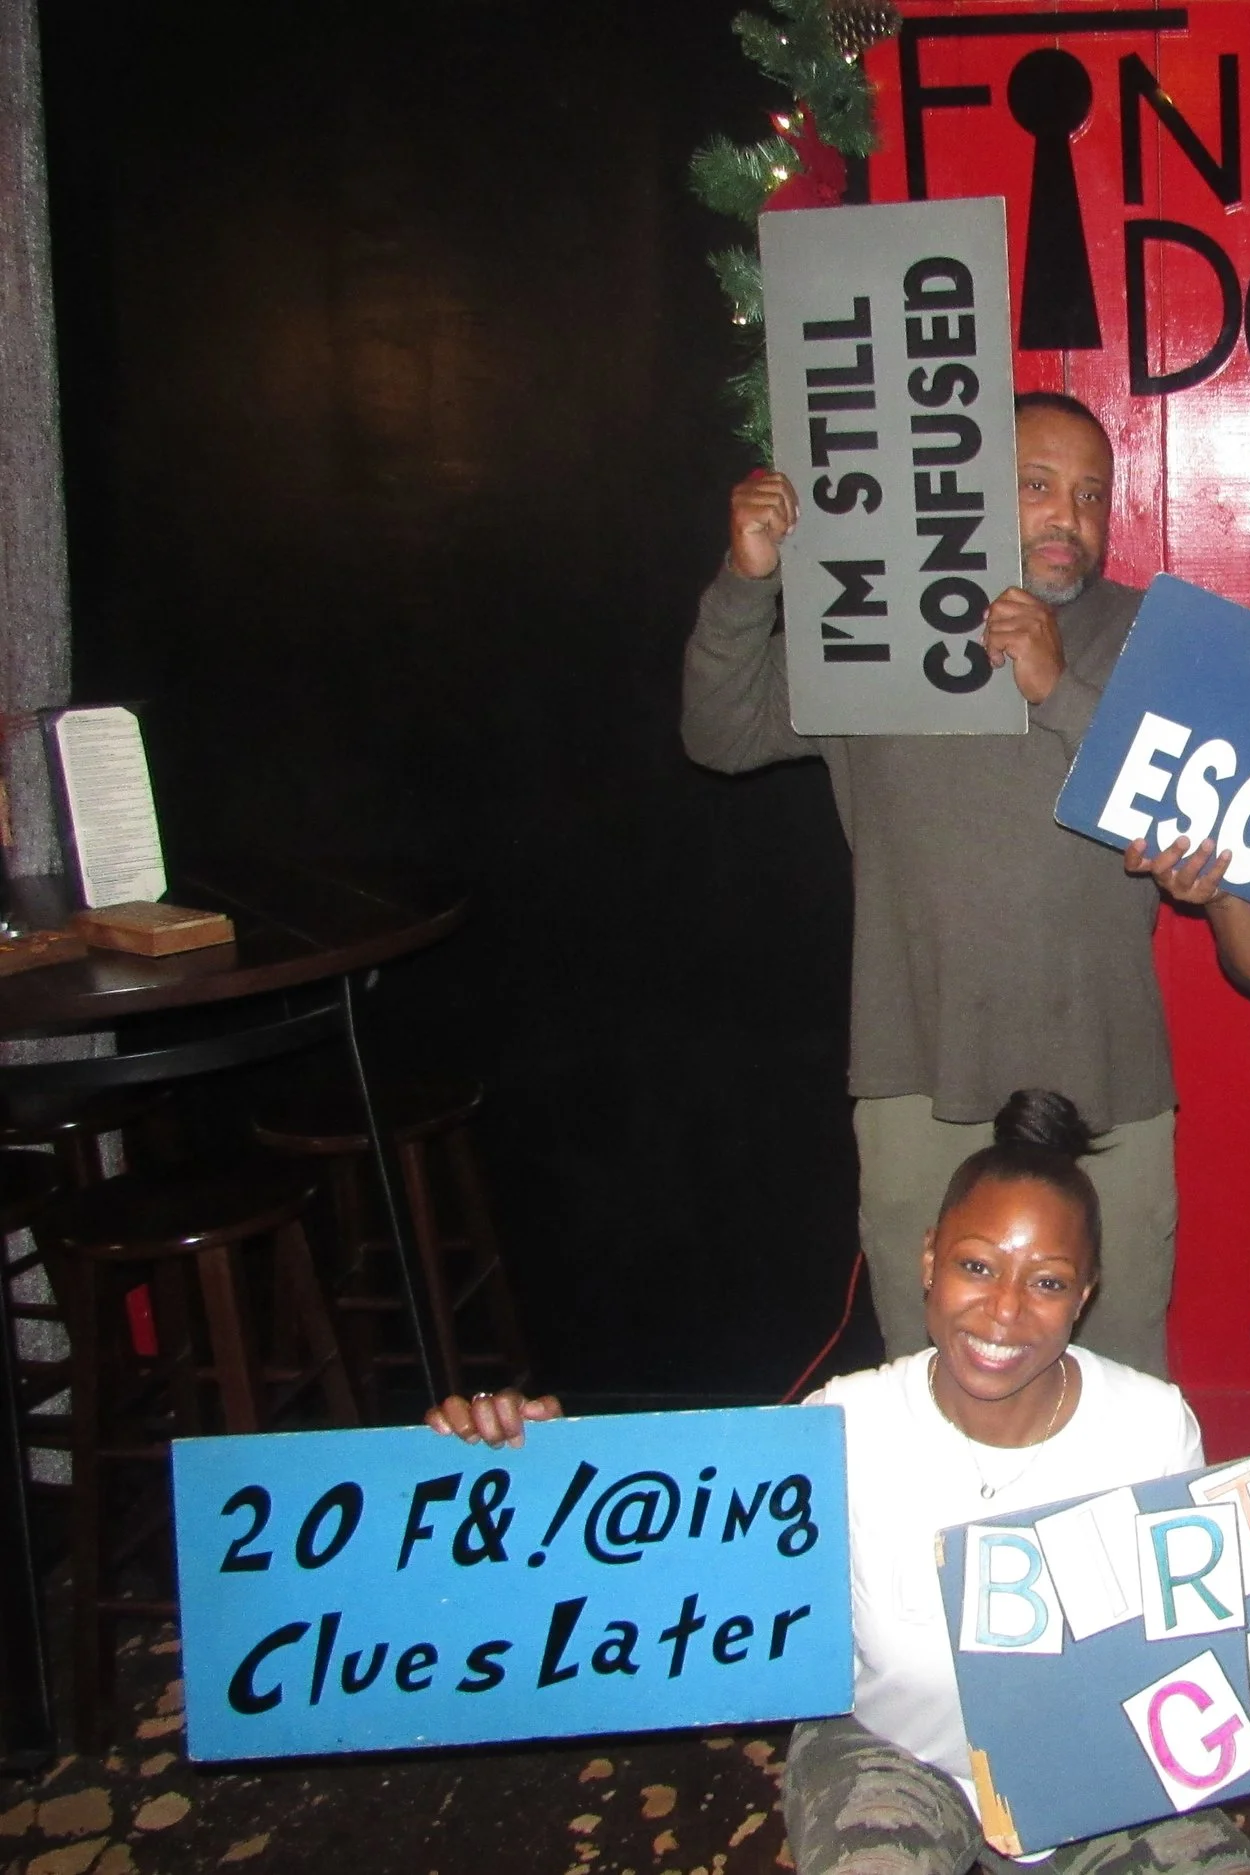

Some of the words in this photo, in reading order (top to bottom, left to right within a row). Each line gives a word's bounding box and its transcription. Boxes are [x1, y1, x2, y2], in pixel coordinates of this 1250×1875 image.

[802, 296, 883, 515] STILL
[903, 256, 994, 694] CONFUSED
[818, 559, 891, 663] I'M
[219, 1480, 364, 1572] 20
[226, 1611, 514, 1715] Clues
[536, 1593, 811, 1689] Later
